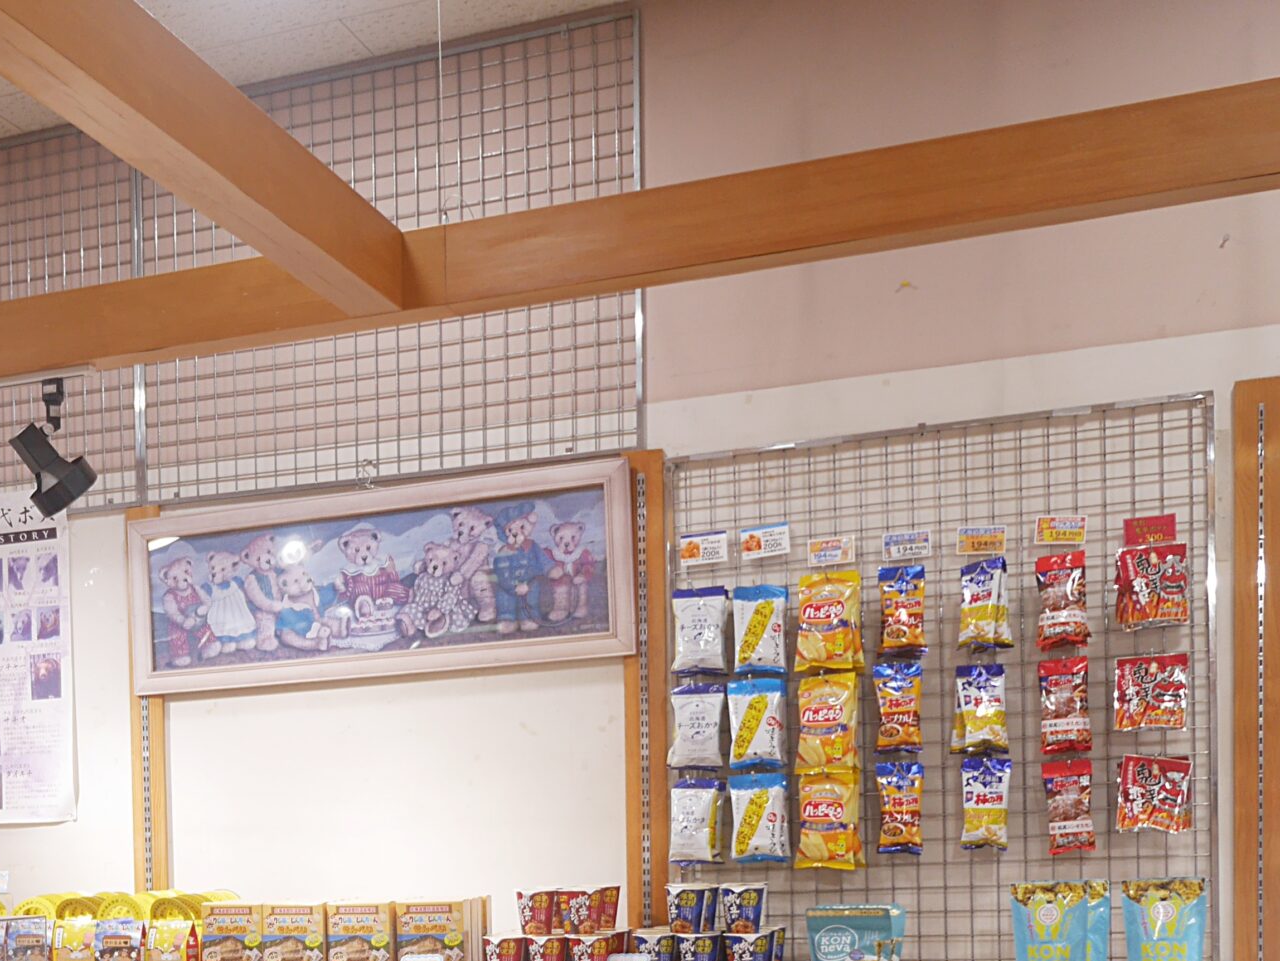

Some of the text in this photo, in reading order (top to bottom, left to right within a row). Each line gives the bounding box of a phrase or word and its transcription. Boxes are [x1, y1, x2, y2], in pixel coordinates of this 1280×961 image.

[821, 935, 851, 945] KON
[820, 944, 851, 953] neva
[1026, 944, 1071, 960] KON
[1140, 940, 1188, 958] KON
